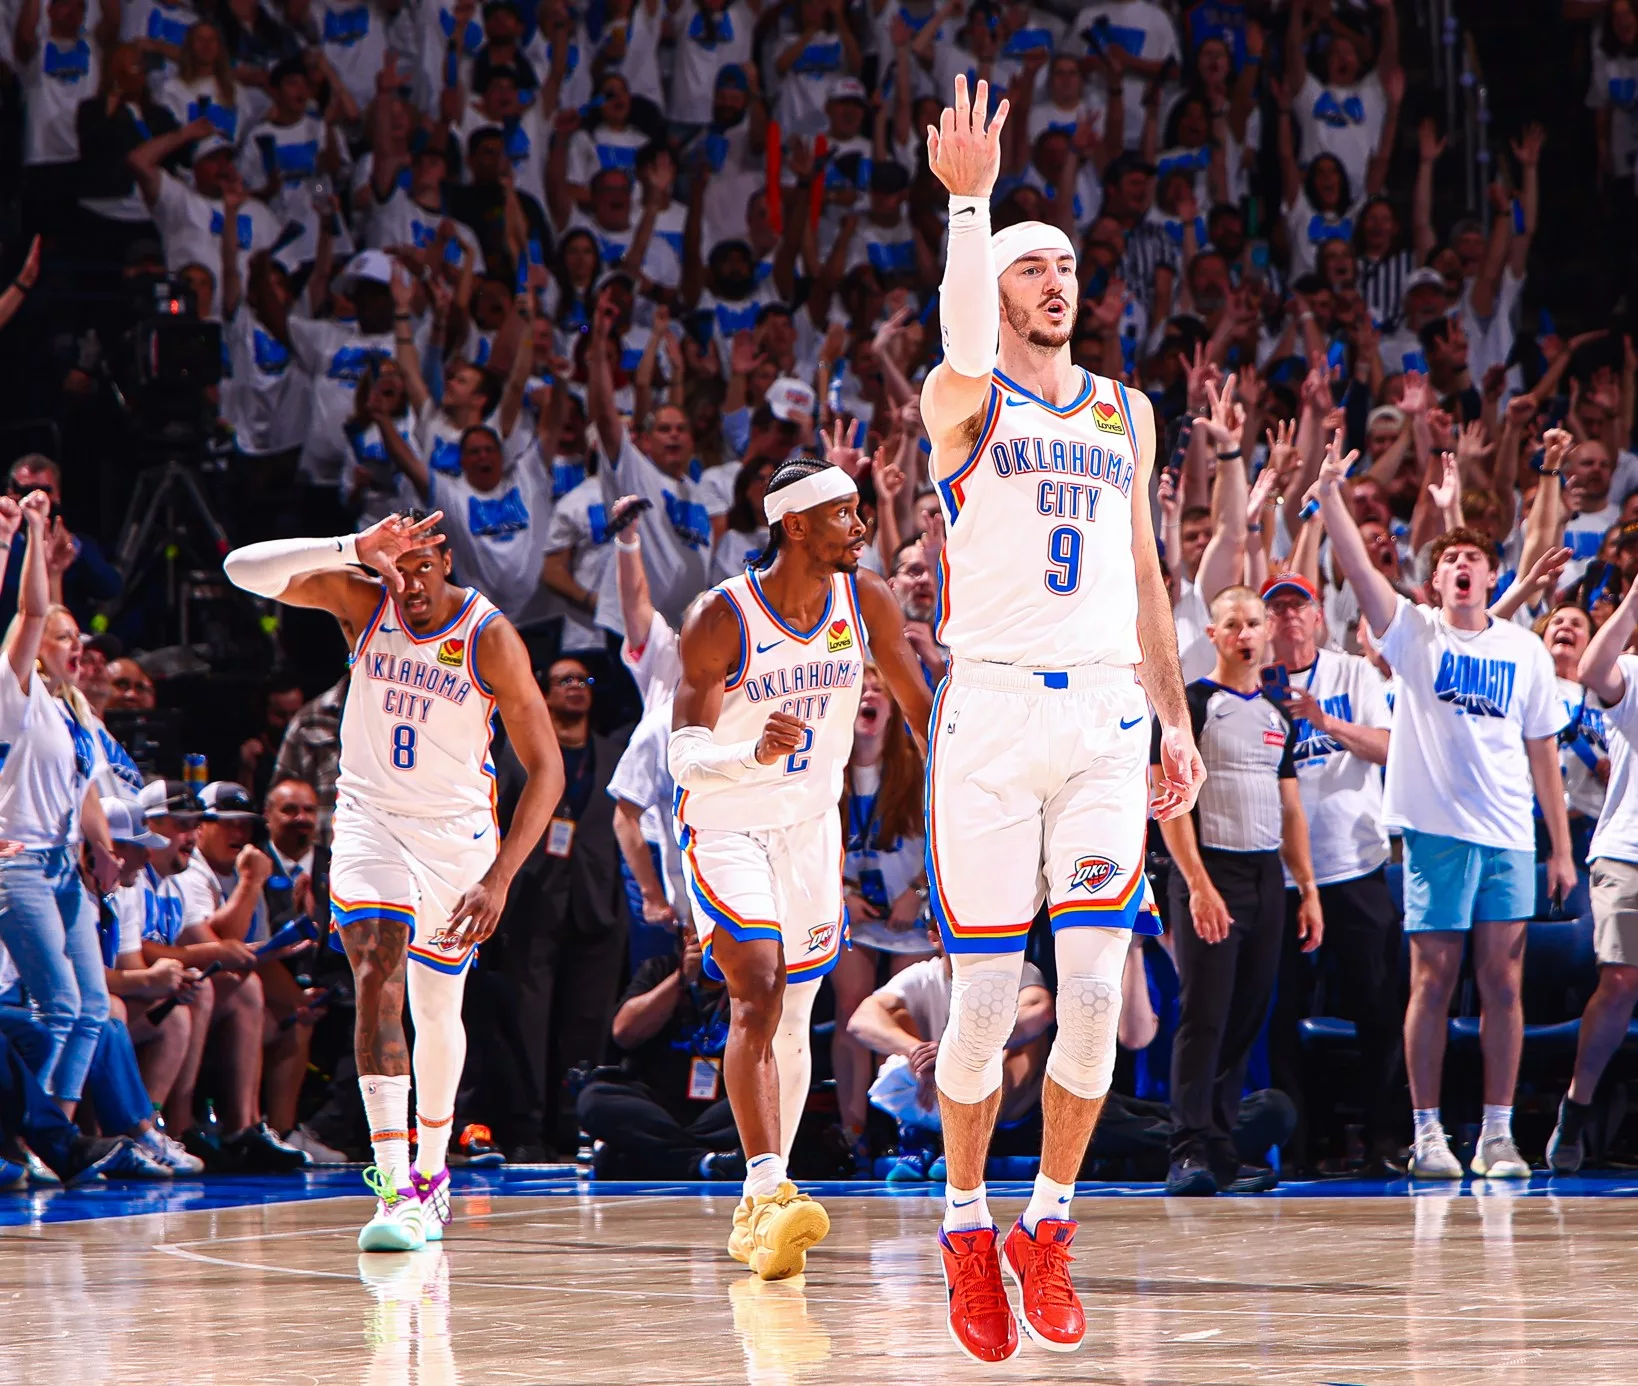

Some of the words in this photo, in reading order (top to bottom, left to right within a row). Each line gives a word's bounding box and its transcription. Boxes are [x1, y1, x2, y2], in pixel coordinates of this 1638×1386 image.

[991, 437, 1135, 499] OKLAHOMA
[1036, 479, 1101, 522] CITY
[1044, 524, 1084, 596] 9
[383, 687, 434, 723] CITY
[390, 722, 418, 772] 8
[783, 725, 816, 776] 2
[1071, 863, 1109, 887] OKC
